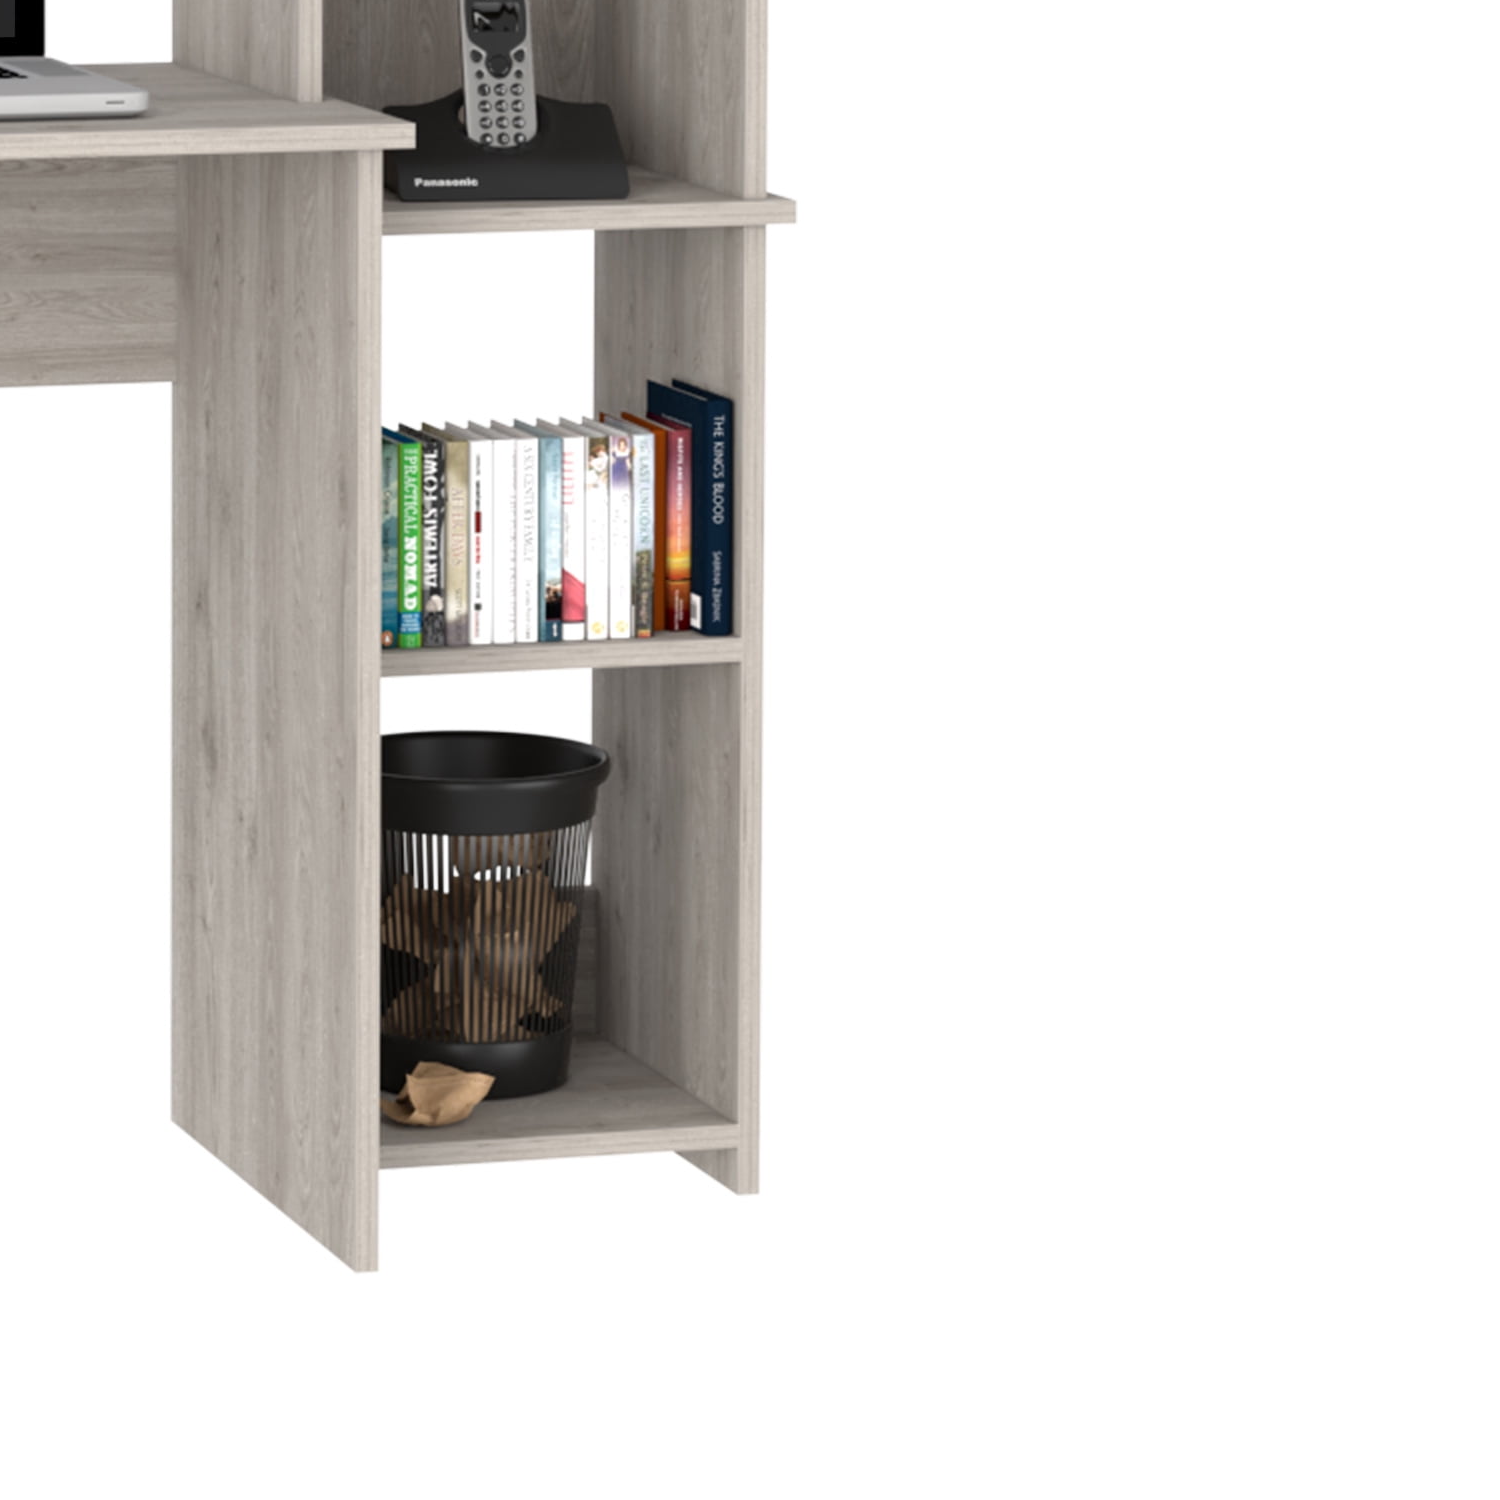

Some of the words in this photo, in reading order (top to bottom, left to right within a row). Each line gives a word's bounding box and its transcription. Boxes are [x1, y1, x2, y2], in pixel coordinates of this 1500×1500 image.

[413, 176, 479, 188] Panasonic
[712, 414, 725, 437] THE
[423, 449, 439, 503] FOWL
[640, 456, 650, 483] LAST
[712, 441, 726, 479] KING'S
[403, 455, 419, 534] PRACTICAL
[639, 487, 651, 545] UNICORN
[712, 482, 725, 525] BLOOD
[423, 507, 439, 589] ARTEMIS
[404, 535, 418, 611] NOMAD
